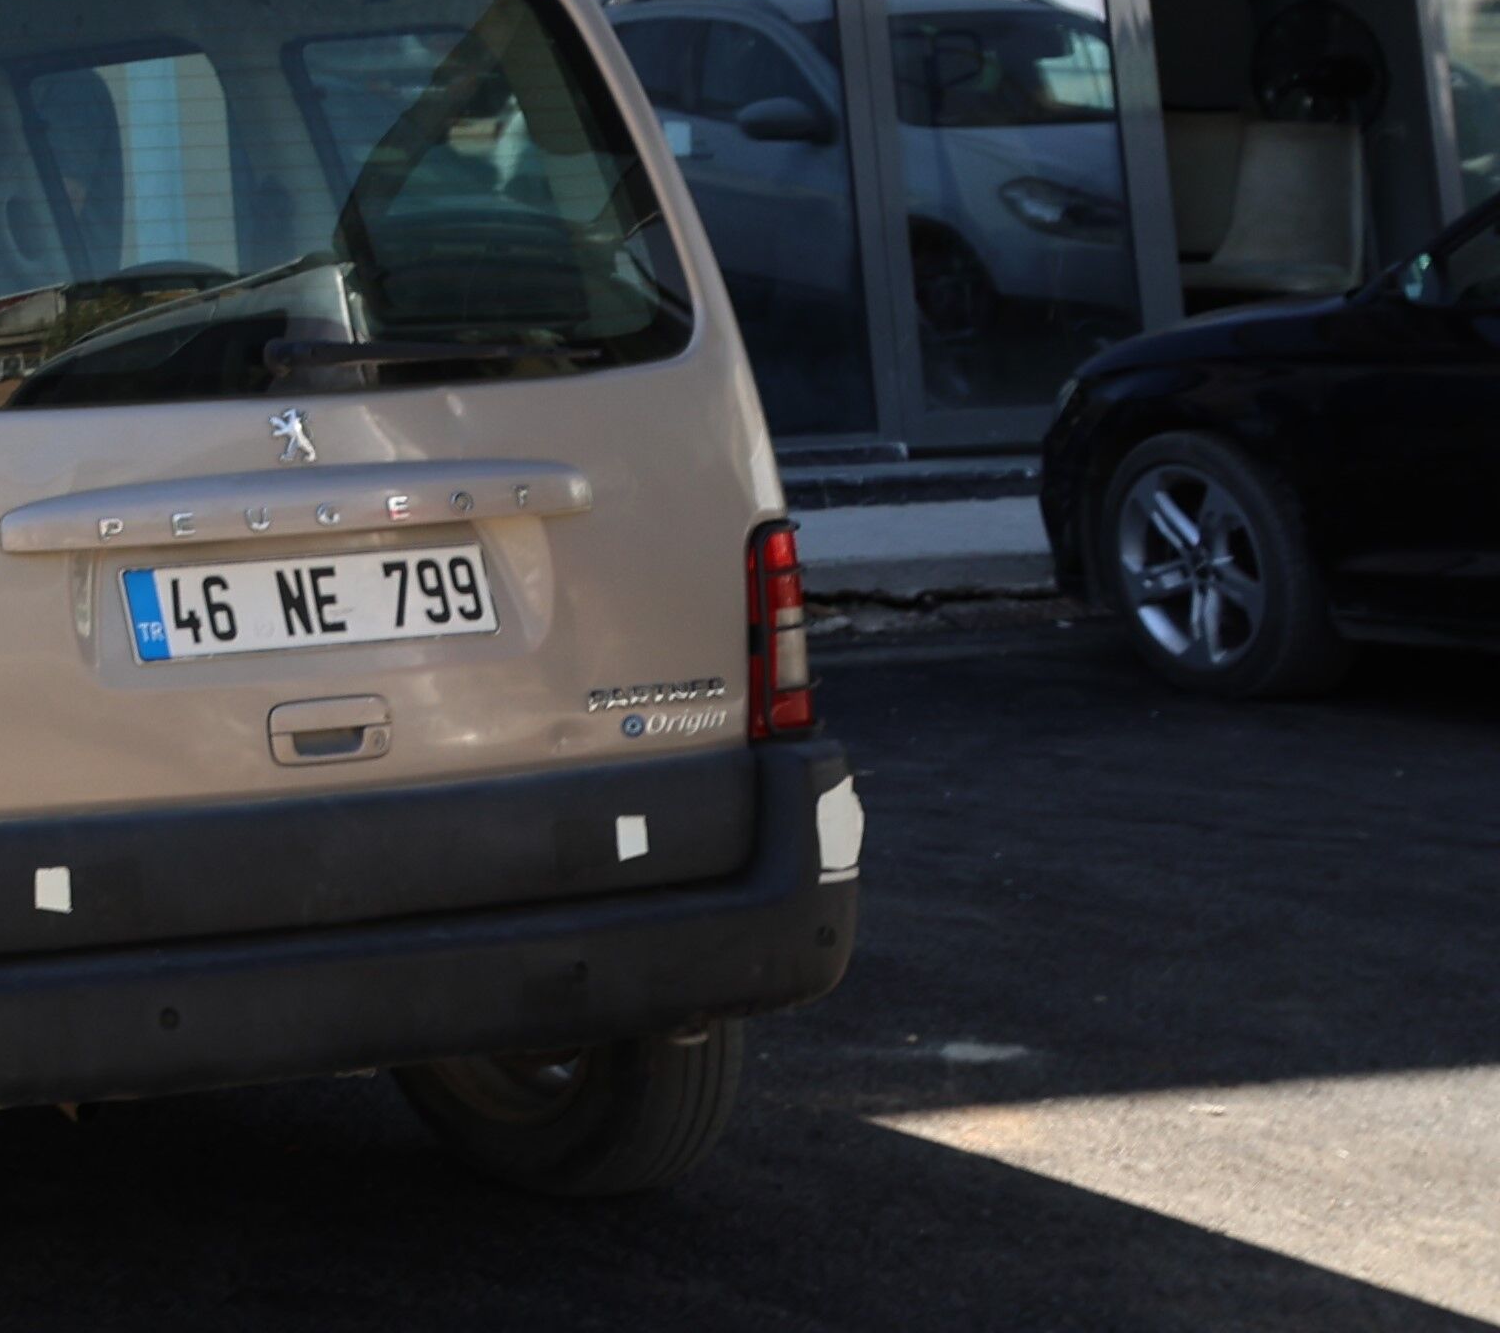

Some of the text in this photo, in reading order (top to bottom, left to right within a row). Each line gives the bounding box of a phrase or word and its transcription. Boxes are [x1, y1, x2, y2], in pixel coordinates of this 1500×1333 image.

[98, 483, 530, 540] PEUGEOT
[137, 555, 485, 644] TR 46 NE 799
[587, 676, 726, 712] PARTNER
[646, 705, 728, 737] Origin
